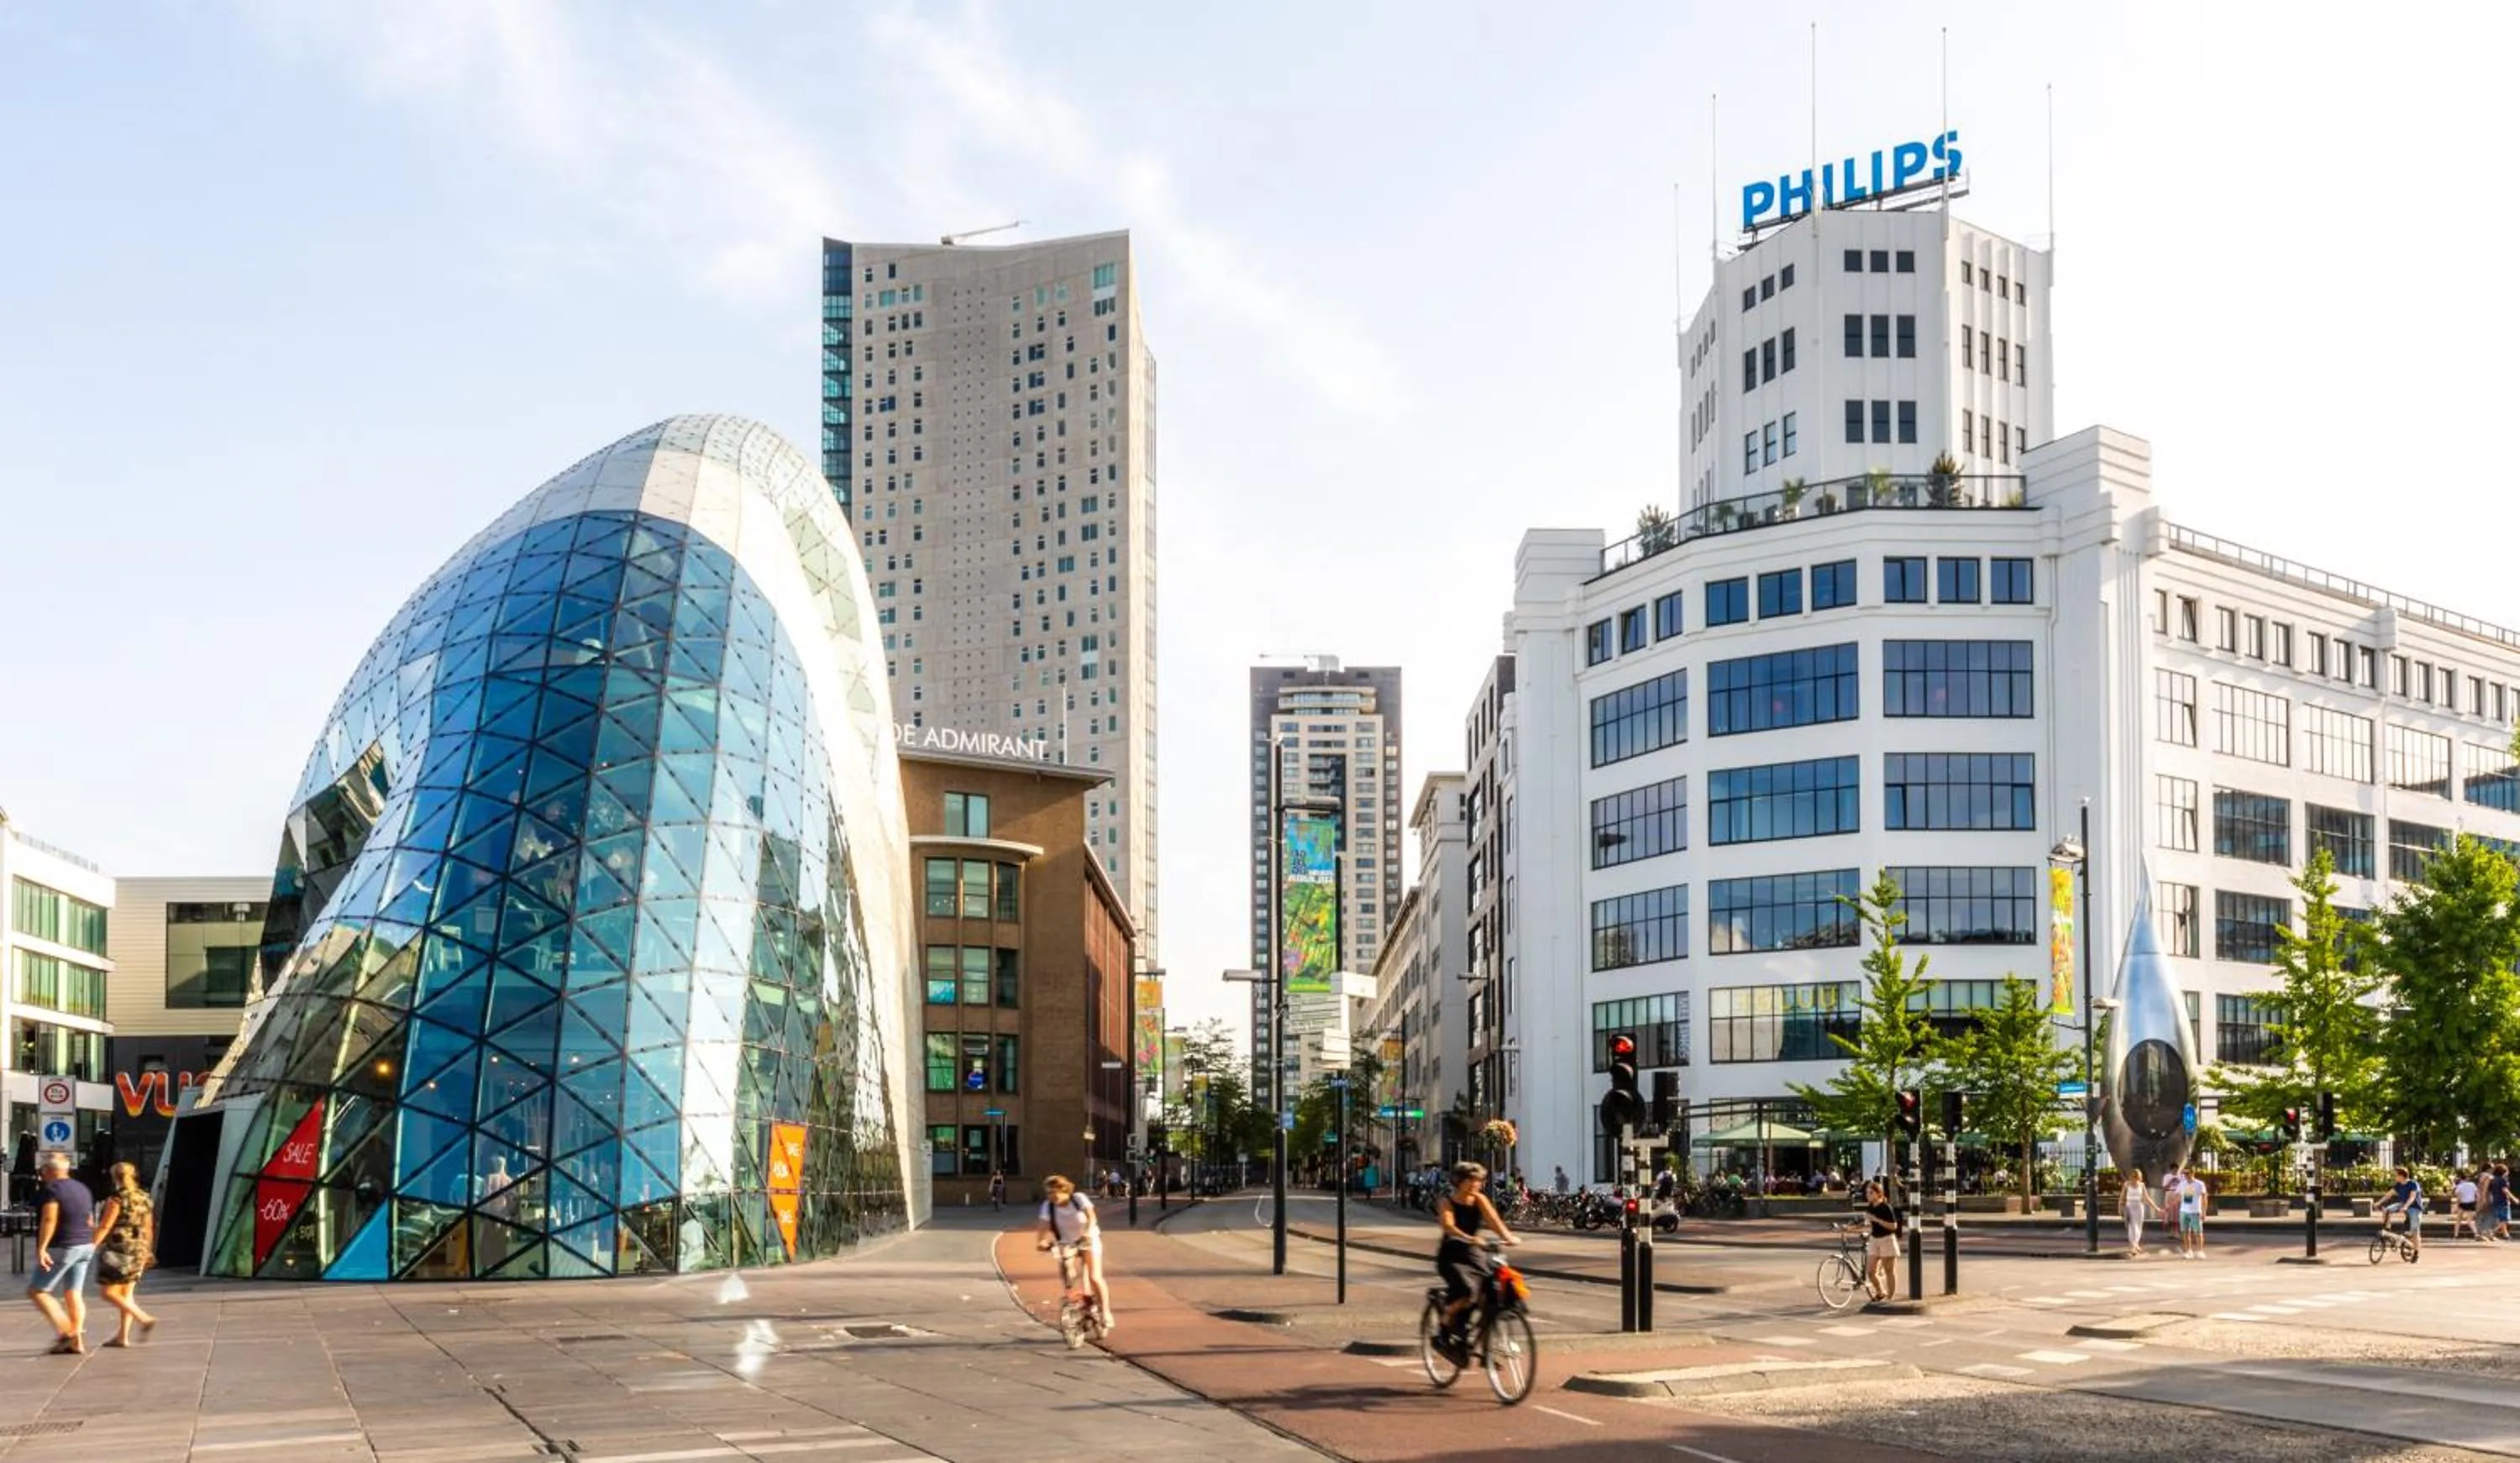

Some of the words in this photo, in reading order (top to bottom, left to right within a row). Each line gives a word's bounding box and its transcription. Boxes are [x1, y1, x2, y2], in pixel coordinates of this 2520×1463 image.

[1743, 130, 1962, 229] PHILIPS
[924, 727, 1048, 759] ADMIRANT
[283, 1142, 315, 1164] SALE
[260, 1198, 290, 1220] -60%
